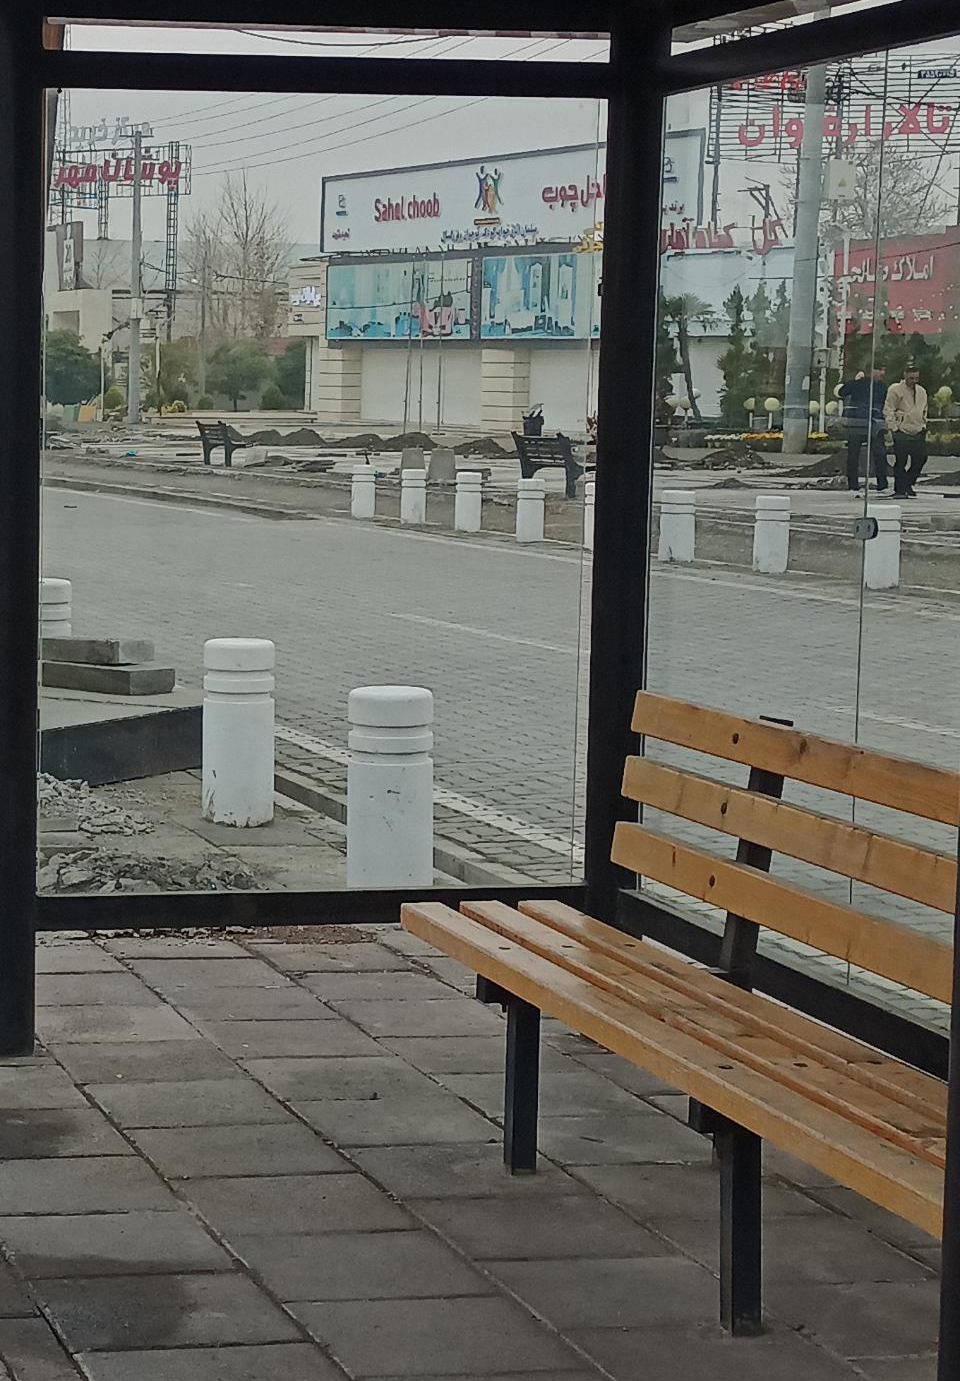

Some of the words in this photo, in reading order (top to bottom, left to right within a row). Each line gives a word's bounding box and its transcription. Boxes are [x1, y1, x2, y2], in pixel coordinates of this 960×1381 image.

[883, 102, 950, 142] تالار
[407, 192, 441, 220] choob
[541, 184, 579, 213] چوب
[891, 255, 934, 281] املاک
